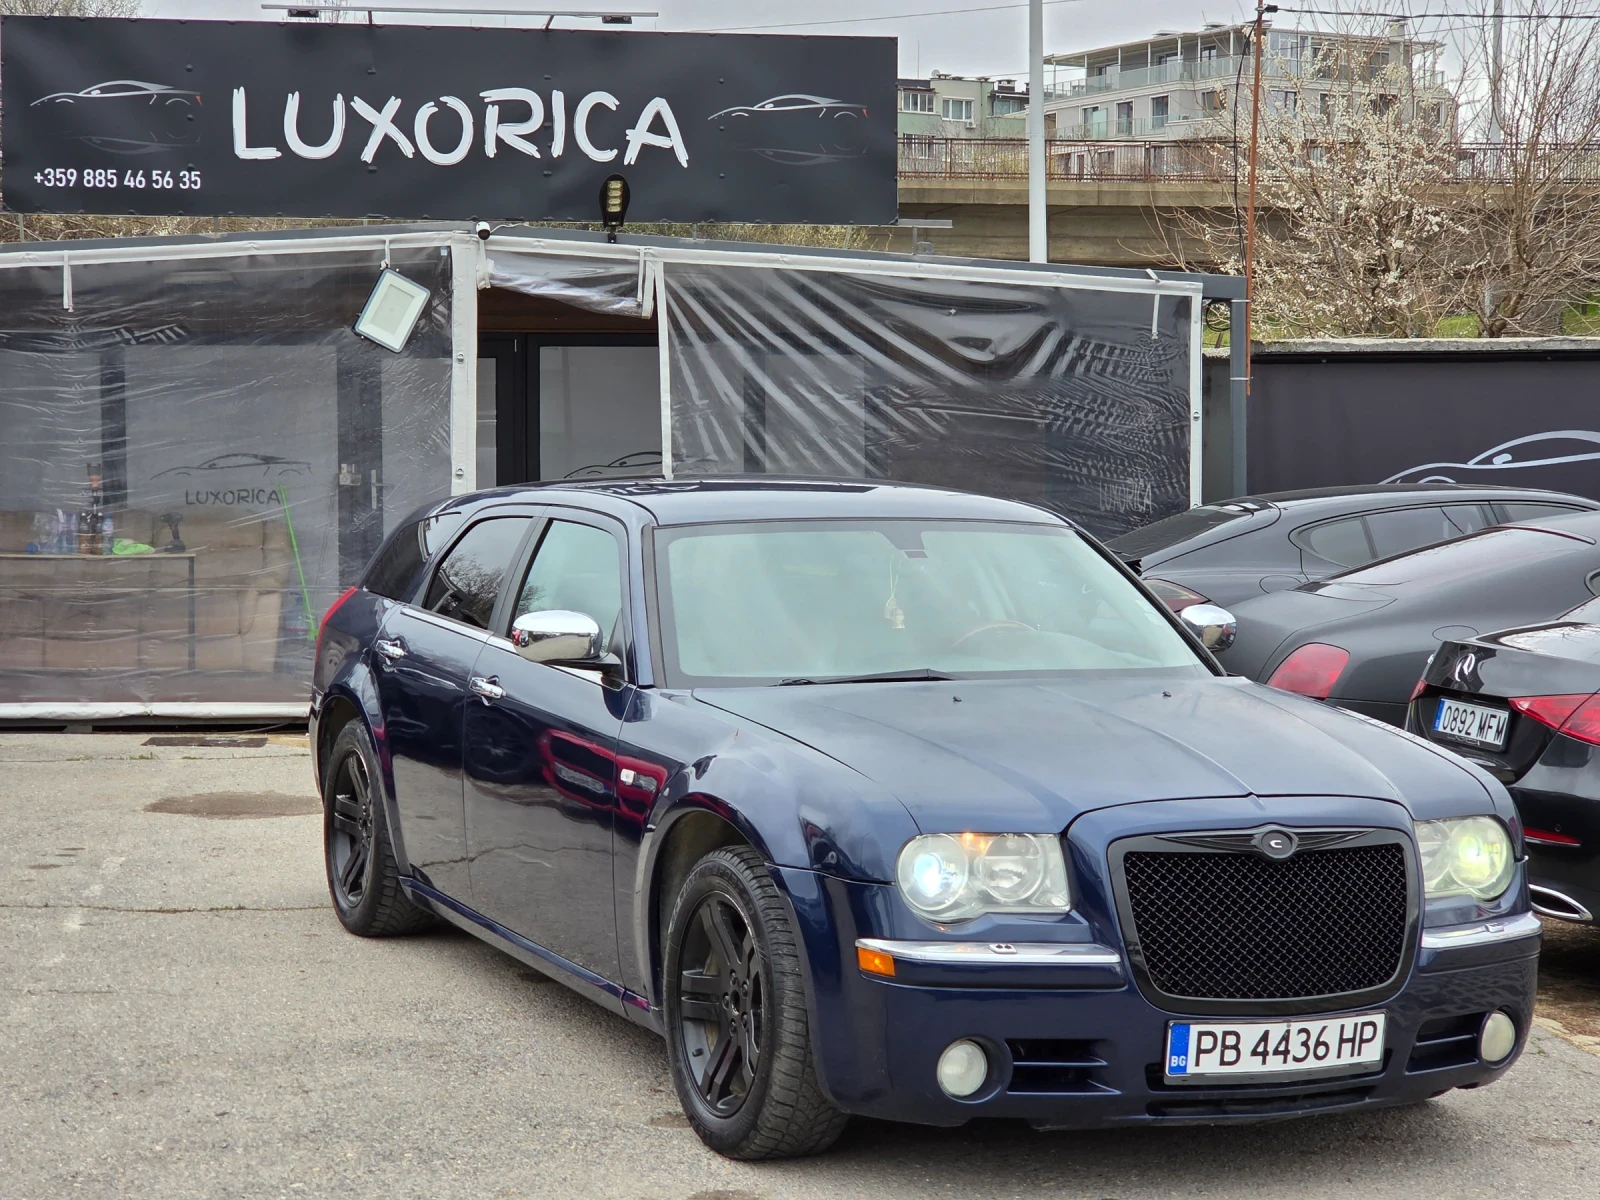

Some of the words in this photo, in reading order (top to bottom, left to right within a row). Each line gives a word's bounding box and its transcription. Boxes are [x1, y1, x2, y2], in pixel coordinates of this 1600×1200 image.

[232, 86, 689, 168] LUXORICA
[34, 168, 77, 187] +359
[83, 169, 117, 188] 885
[123, 170, 146, 189] 46
[152, 170, 174, 189] 56
[179, 171, 201, 190] 35
[185, 488, 281, 505] LUXORICA
[1442, 705, 1476, 736] 0892
[1476, 711, 1507, 743] MFM
[1194, 1030, 1242, 1067] PB
[1250, 1025, 1330, 1066] 4436
[1336, 1020, 1378, 1060] HP
[1170, 1056, 1187, 1067] BG
